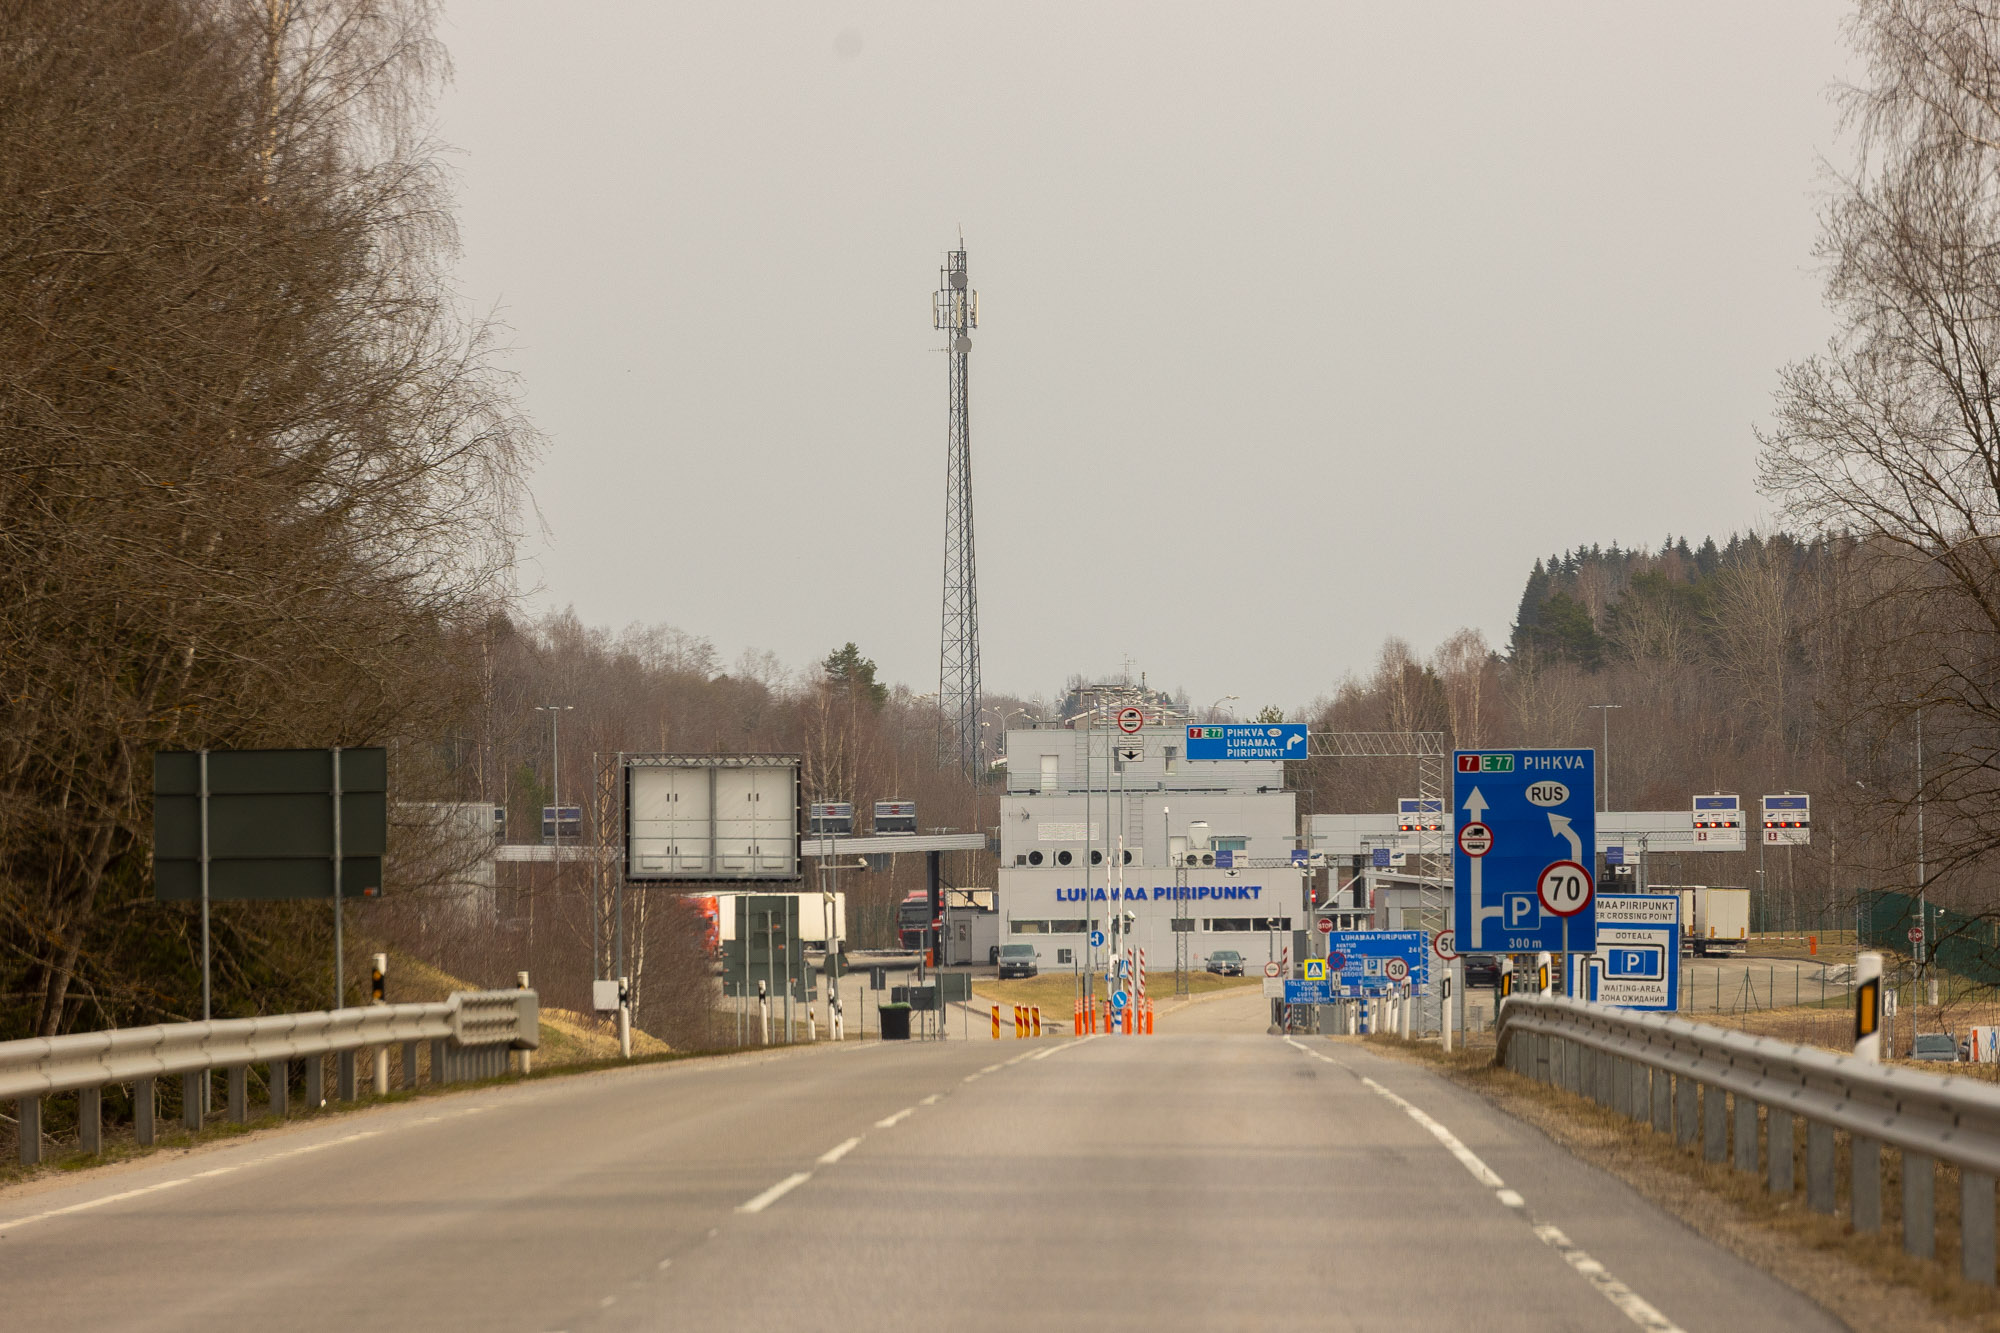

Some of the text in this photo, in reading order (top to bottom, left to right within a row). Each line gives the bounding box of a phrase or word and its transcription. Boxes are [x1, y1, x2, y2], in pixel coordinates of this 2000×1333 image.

[1193, 729, 1199, 738] 7
[1227, 728, 1265, 737] PIHKVA
[1227, 739, 1277, 747] LUHAMAA
[1227, 749, 1285, 758] PIIRIPUNKT
[1465, 757, 1473, 770] 7
[1524, 756, 1585, 770] PIHKVA
[1531, 787, 1564, 801] RUS
[1153, 886, 1262, 901] PIIRIPUNKT
[1550, 876, 1581, 901] 70
[1620, 901, 1675, 911] PIIRIPUNKT
[1607, 912, 1648, 920] CROSSING
[1649, 913, 1673, 921] POINT
[1616, 932, 1653, 940] OOTEALA
[1509, 938, 1543, 949] 300 m
[1391, 964, 1404, 975] 30
[1604, 984, 1662, 993] WAITING-AREA
[1600, 994, 1665, 1003] ЗОНА ОЖИДАНИЯ
